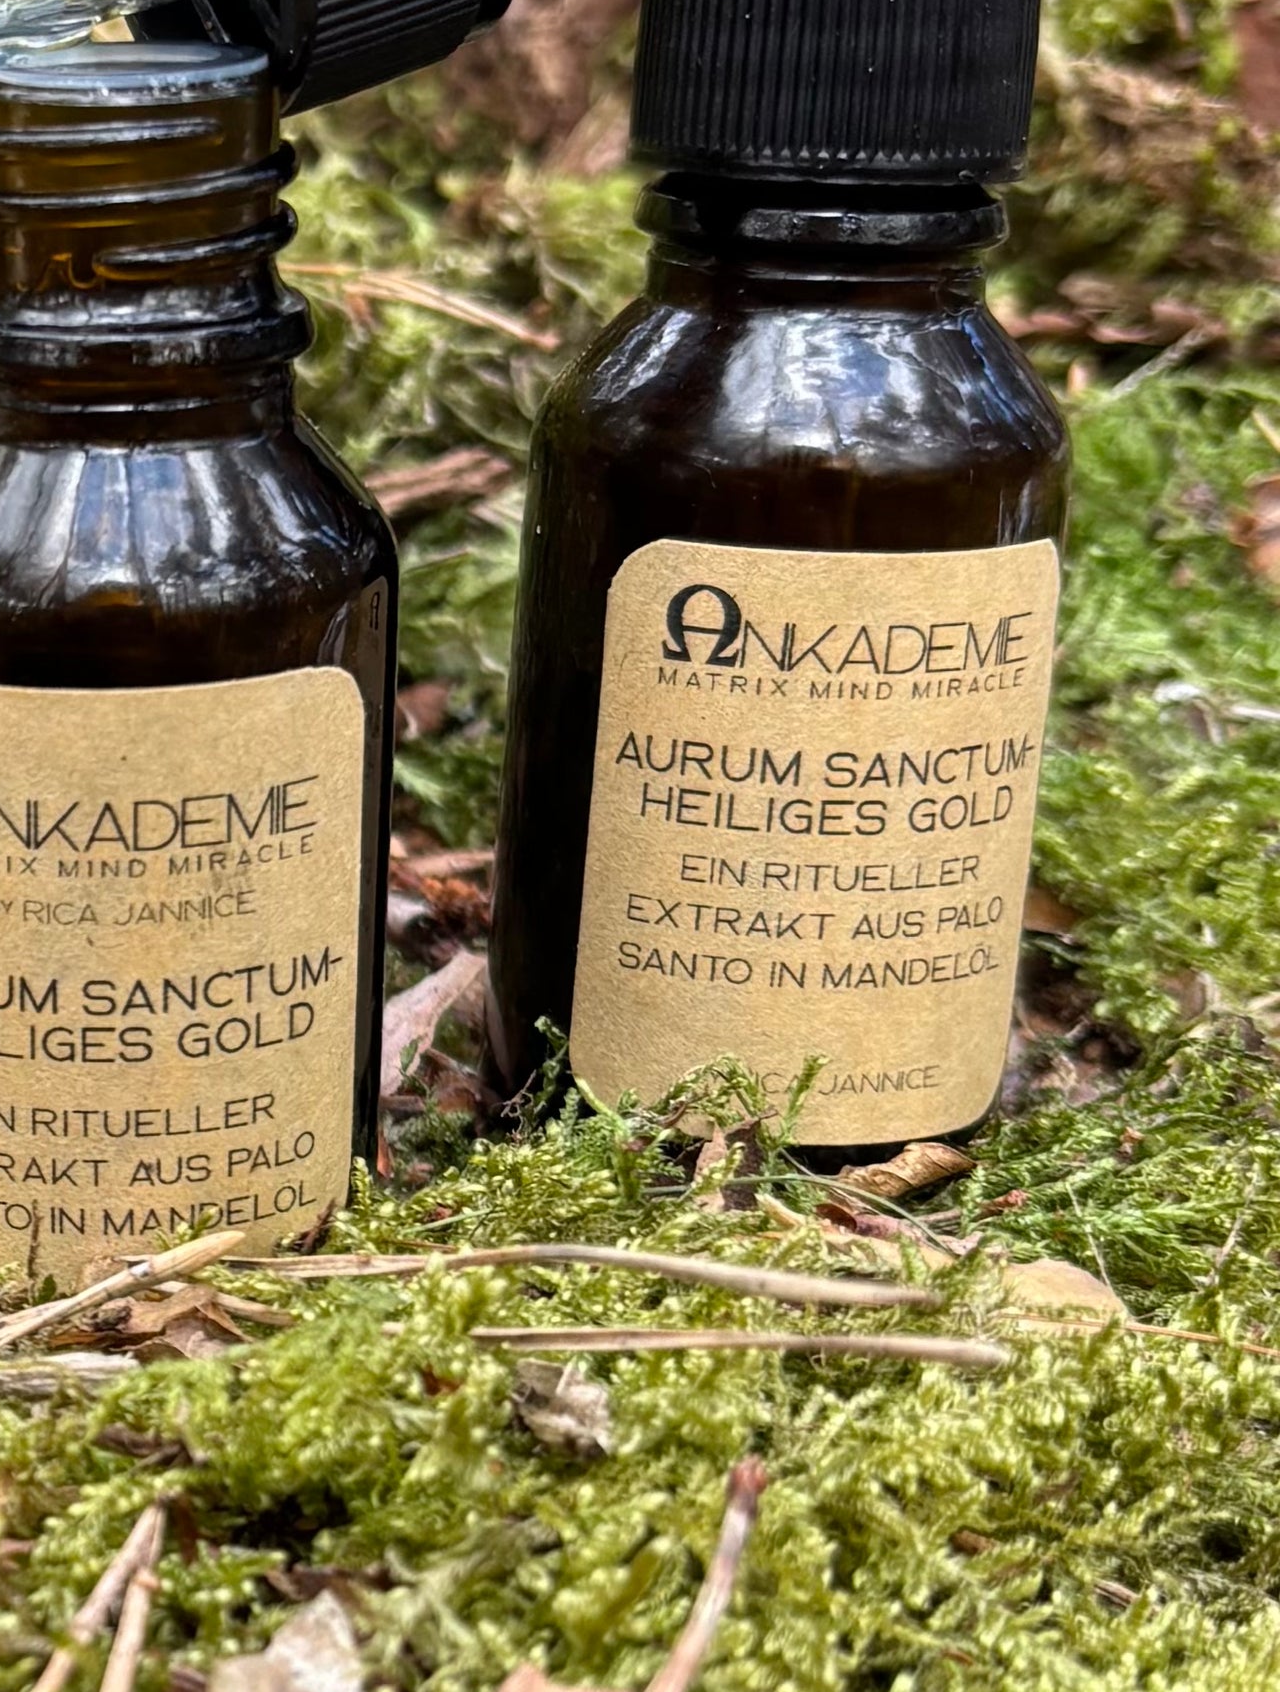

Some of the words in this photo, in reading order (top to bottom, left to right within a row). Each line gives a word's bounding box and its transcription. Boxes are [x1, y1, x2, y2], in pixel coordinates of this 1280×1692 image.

[657, 666, 787, 696] MATRIX
[810, 681, 893, 701] MIND
[912, 667, 1025, 700] MIRACLE
[616, 731, 802, 787] AURUM
[640, 782, 888, 836] HEILIGES
[908, 785, 1013, 833] GOLD
[57, 858, 146, 879] MIND
[168, 833, 314, 876] MIRACLE
[681, 854, 747, 887] EIN
[764, 855, 979, 892] RITUELLER
[23, 900, 98, 926] RICA
[114, 890, 256, 926] JANNICE
[627, 893, 835, 941] EXTRAKT
[851, 910, 924, 939] AUS
[937, 896, 1003, 934] PALO
[82, 946, 343, 1017] SANCTUM-
[618, 942, 753, 985] SANTO
[770, 961, 806, 989] IN
[178, 1002, 314, 1058] GOLD
[818, 1065, 941, 1096] JANNICE
[31, 1093, 276, 1138] RITUELLER
[129, 1154, 211, 1187] AUS
[227, 1131, 315, 1178] PALO
[50, 1206, 85, 1235] IN
